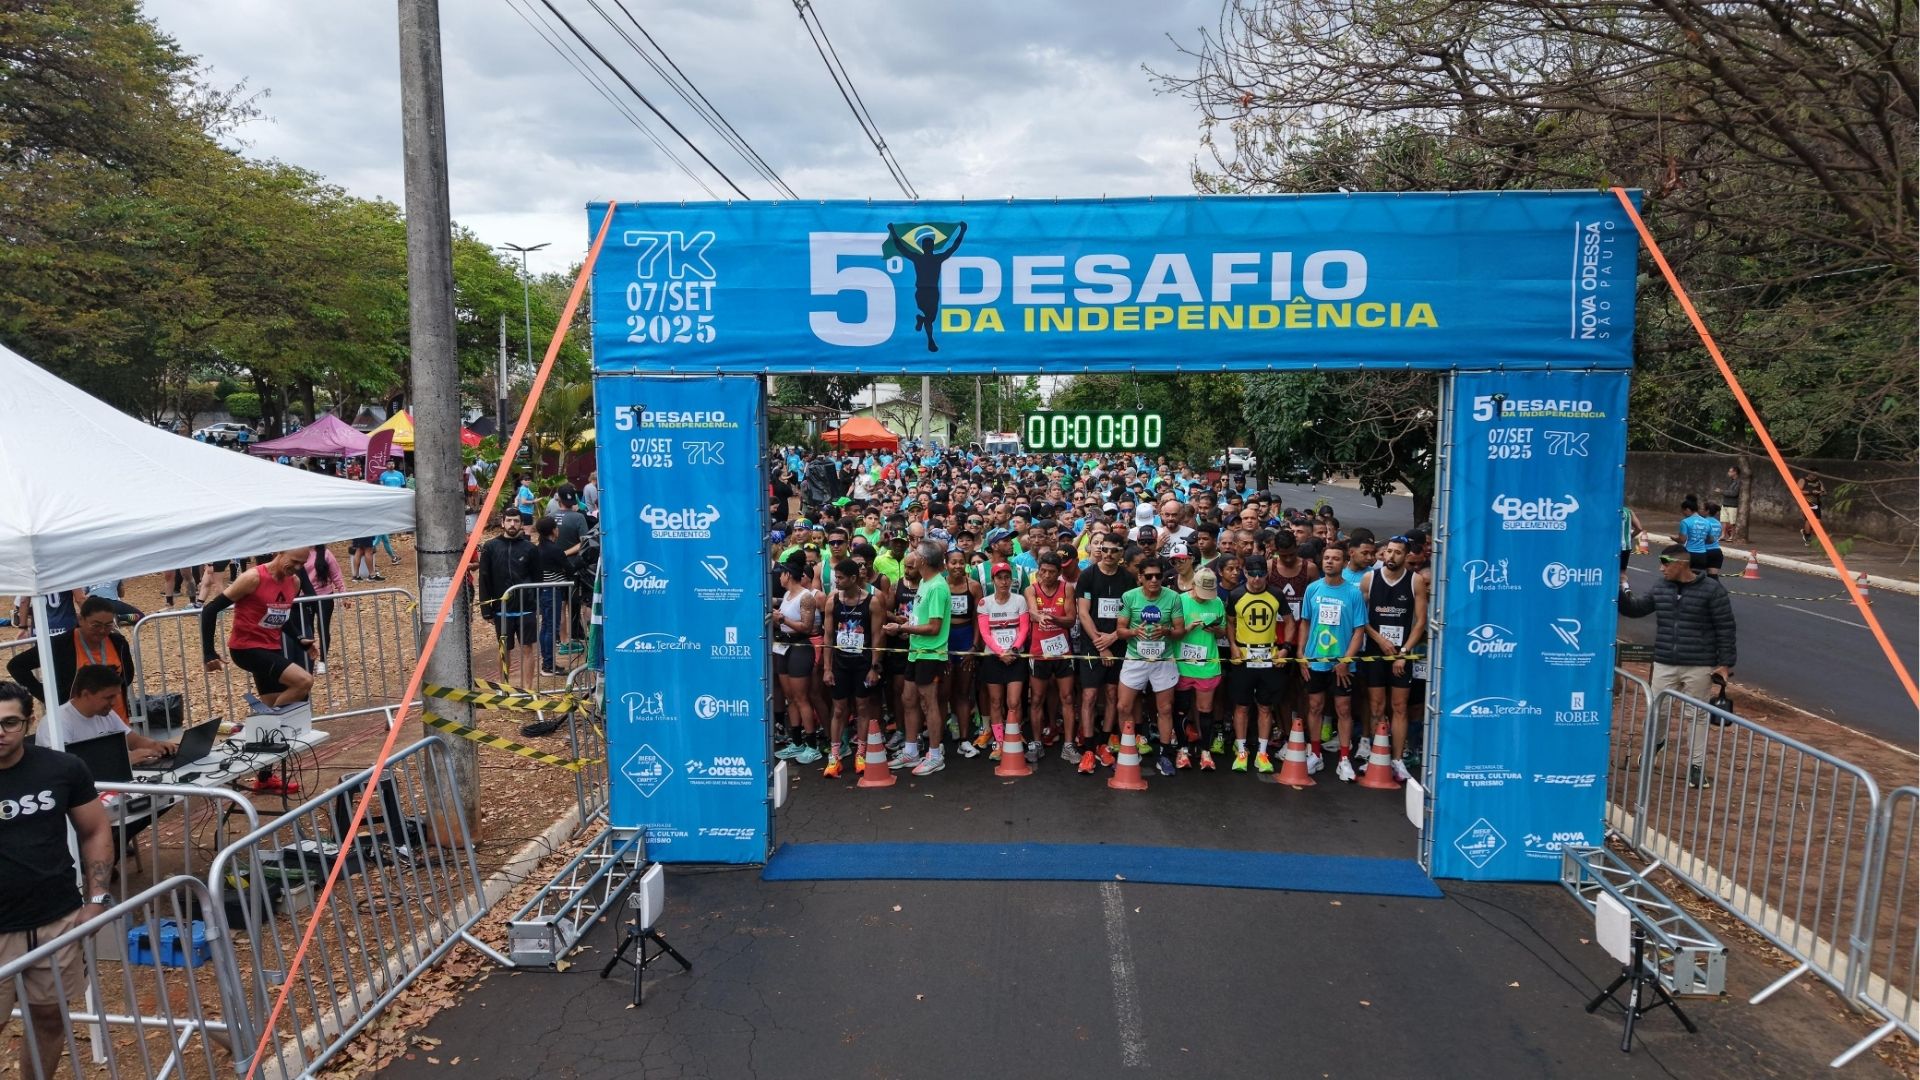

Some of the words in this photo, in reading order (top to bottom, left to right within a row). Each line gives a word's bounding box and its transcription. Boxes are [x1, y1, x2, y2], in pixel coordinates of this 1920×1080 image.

[623, 230, 716, 279] 7K
[1581, 221, 1602, 291] ODESSA
[1600, 220, 1615, 289] PAULO
[941, 249, 1368, 305] DESAFIO
[626, 281, 717, 313] 07/SET
[941, 307, 1005, 333] DA
[1023, 295, 1439, 333] INDEPENDÊNCIA
[1580, 294, 1598, 340] NOVA
[1599, 301, 1612, 339] SÃO
[626, 314, 717, 344] 2025
[1501, 399, 1593, 412] DESAFIO
[641, 410, 725, 423] DESAFIO
[1519, 410, 1606, 419] INDEPENDÊNCIA
[641, 421, 655, 429] DA
[658, 420, 739, 429] INDEPENDÊNCIA
[1028, 414, 1161, 448] 00:00:00
[1488, 427, 1534, 444] 07/SET
[631, 438, 673, 453] 07/SET
[1544, 430, 1590, 457] 7K
[683, 441, 725, 465] 7K
[1487, 444, 1532, 460] 2025
[631, 454, 673, 468] 2025
[1502, 496, 1567, 521] Betta
[651, 507, 711, 530] Betta
[1502, 521, 1566, 530] SUPLEMENTOS
[652, 530, 710, 538] SUPLEMENTOS
[1558, 567, 1603, 583] BAHIA
[623, 574, 670, 592] Optilar
[1320, 610, 1338, 619] 0337
[635, 640, 655, 650] Sta.
[656, 640, 701, 650] Terezinha
[710, 645, 752, 656] ROBER
[1046, 643, 1063, 653] 0155
[1141, 648, 1160, 656] 0880
[1468, 638, 1518, 656] Optilar
[1183, 648, 1202, 659] 0726
[708, 699, 749, 713] BAHIA
[1470, 705, 1493, 715] Sta.
[1494, 704, 1542, 715] Terezinha
[1555, 711, 1600, 723] ROBER
[714, 756, 746, 767] NOVA
[708, 767, 753, 777] ODESSA
[1446, 772, 1487, 781] ESPORTES,
[1487, 772, 1522, 780] CULTURA
[1533, 773, 1597, 785] T-SOCKS
[698, 827, 756, 837] T-SOCKS
[1552, 831, 1585, 842] NOVA
